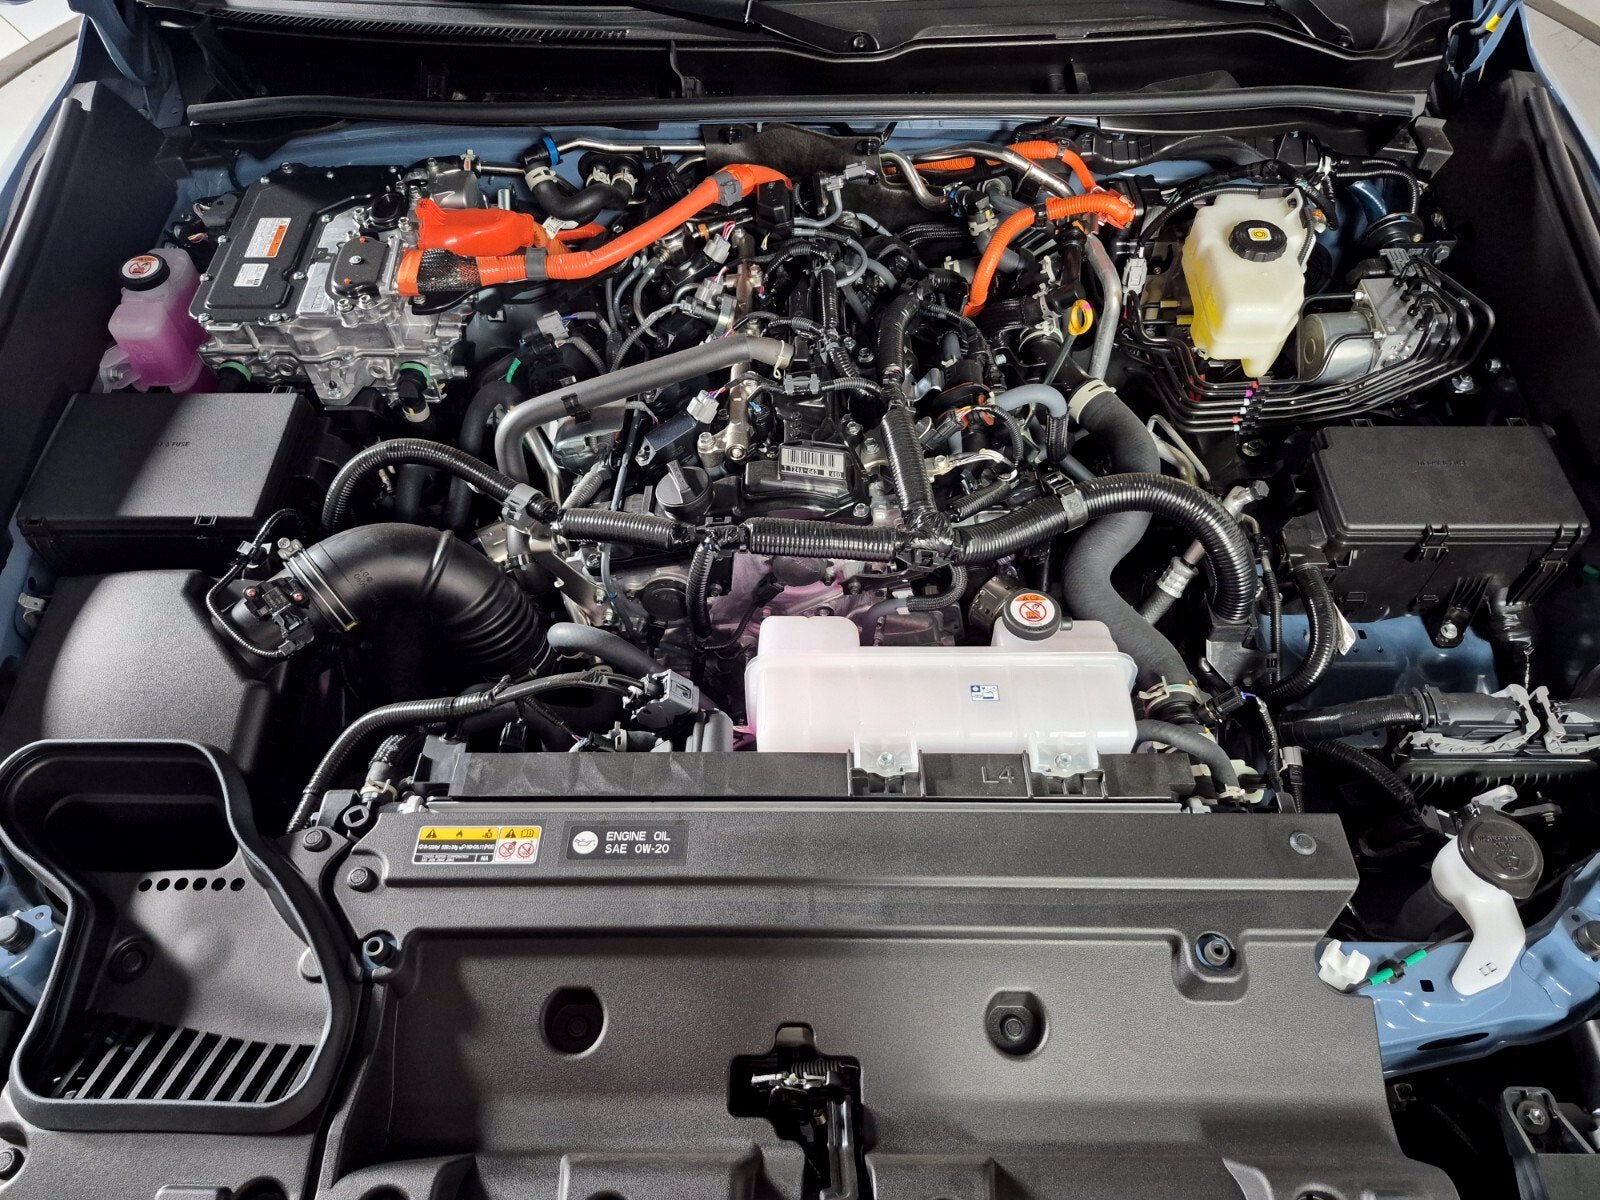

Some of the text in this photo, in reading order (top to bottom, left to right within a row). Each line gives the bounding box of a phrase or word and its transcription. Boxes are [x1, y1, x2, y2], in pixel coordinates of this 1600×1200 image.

[981, 766, 1015, 784] L4
[606, 831, 671, 841] ENGINE OIL
[604, 843, 670, 854] SAE 0W-20
